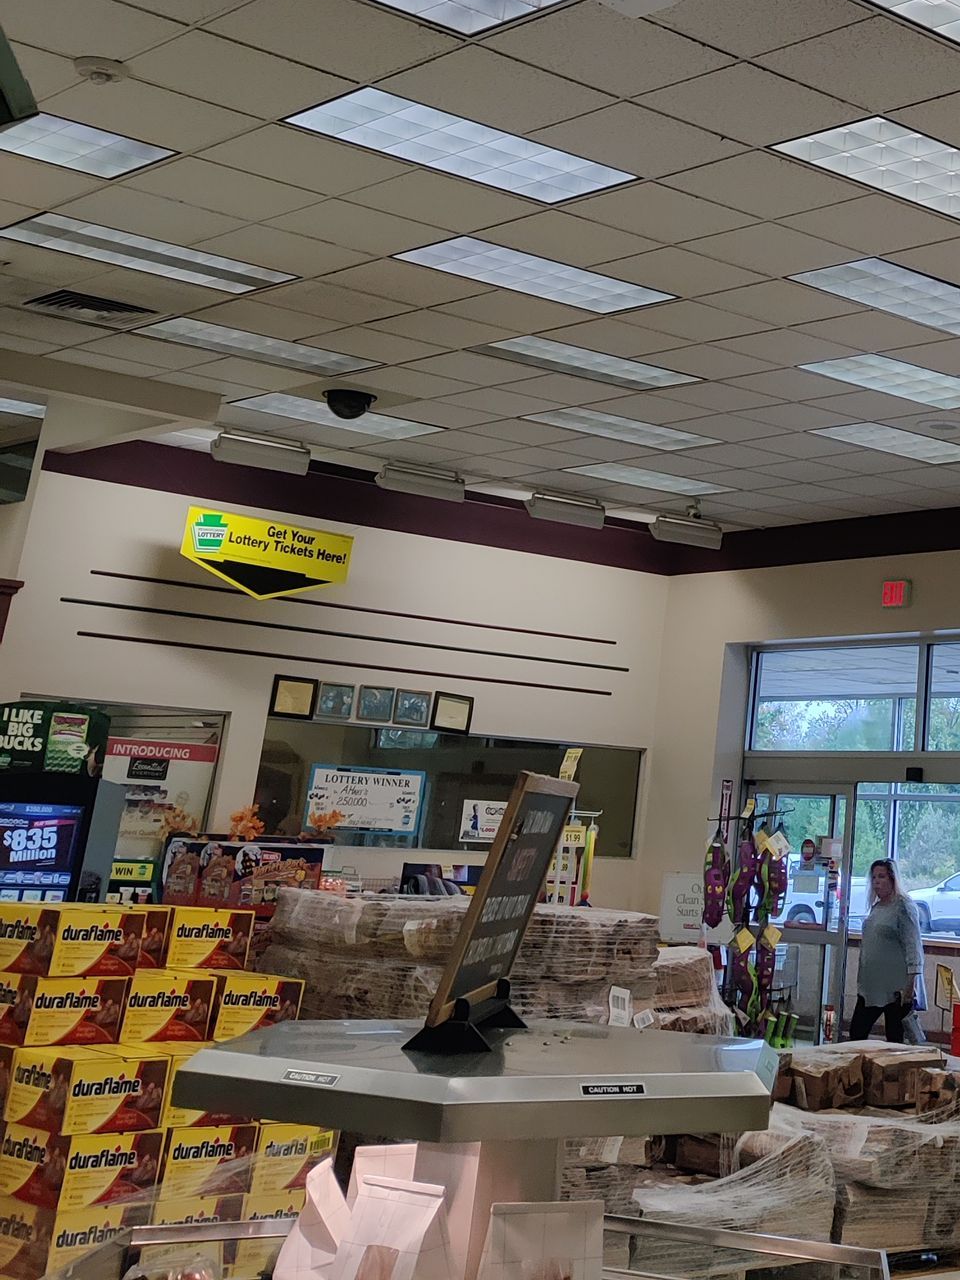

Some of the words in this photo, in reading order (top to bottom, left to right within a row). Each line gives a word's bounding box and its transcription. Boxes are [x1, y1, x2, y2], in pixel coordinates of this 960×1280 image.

[197, 531, 224, 539] LOTTERY
[267, 526, 287, 540] Get
[291, 530, 316, 545] Your
[228, 531, 270, 552] Lottery
[274, 540, 314, 558] Tickets
[316, 548, 347, 565] Here!
[882, 581, 906, 606] EXIT
[3, 707, 9, 721] I
[10, 708, 43, 724] LIKE
[7, 722, 33, 737] BIG
[112, 743, 190, 759] INTRODUCING
[325, 774, 370, 786] LOTTERY
[373, 778, 411, 788] WINNER
[3, 827, 57, 851] $835
[565, 834, 581, 843] $1.99
[9, 848, 56, 863] Million
[115, 867, 134, 877] WIN
[676, 893, 699, 905] Clean
[676, 906, 699, 917] Starts
[62, 925, 123, 942] duraflame
[176, 923, 231, 939] duraflame
[35, 993, 100, 1009] duraflame
[129, 992, 189, 1008] duraflame
[224, 990, 279, 1008] duraflame
[15, 1062, 52, 1090] duraflame
[289, 1073, 316, 1081] CAUTION
[72, 1077, 140, 1097] duraflame
[588, 1086, 620, 1094] CAUTION
[622, 1085, 638, 1093] HOT
[3, 1135, 46, 1164] duraflame
[173, 1141, 234, 1160] duraflame
[69, 1150, 136, 1170] duraflame
